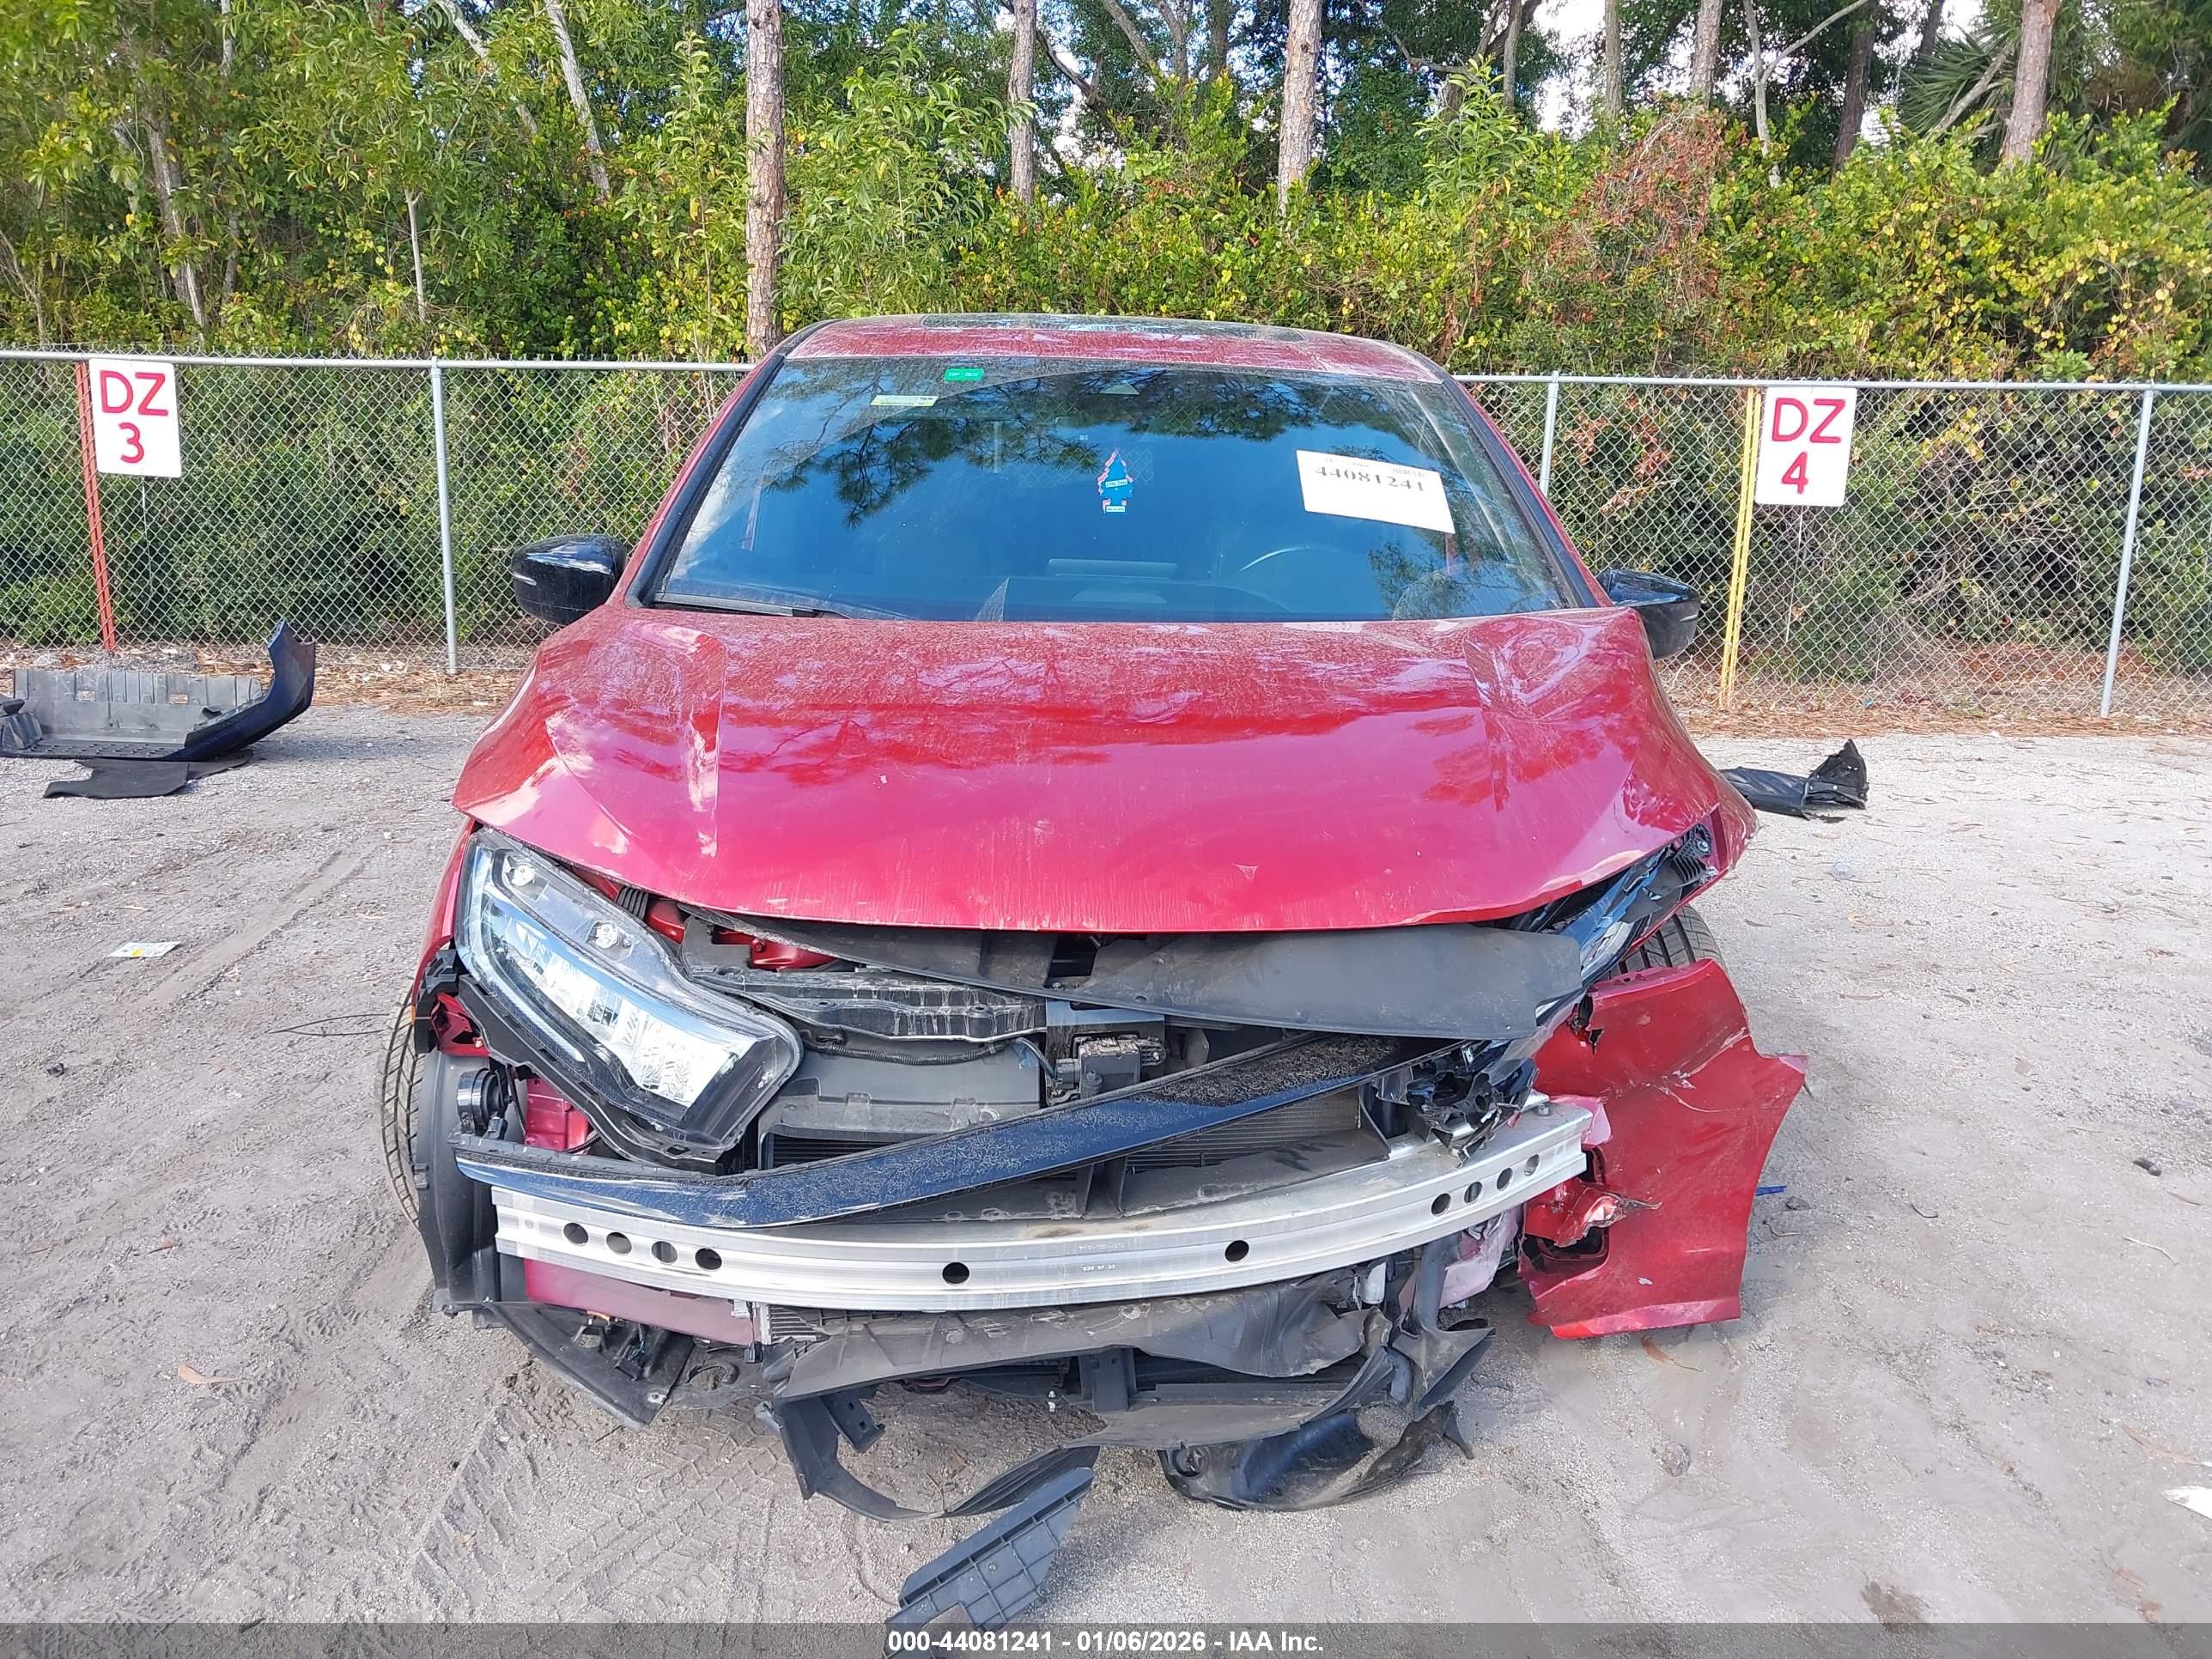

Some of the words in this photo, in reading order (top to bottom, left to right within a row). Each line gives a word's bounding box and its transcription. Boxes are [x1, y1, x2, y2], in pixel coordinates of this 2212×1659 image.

[100, 370, 169, 416] DZ
[1771, 397, 1846, 444] DZ
[118, 422, 145, 464] 3
[1315, 466, 1424, 491] 44081241
[1781, 451, 1809, 495] 4
